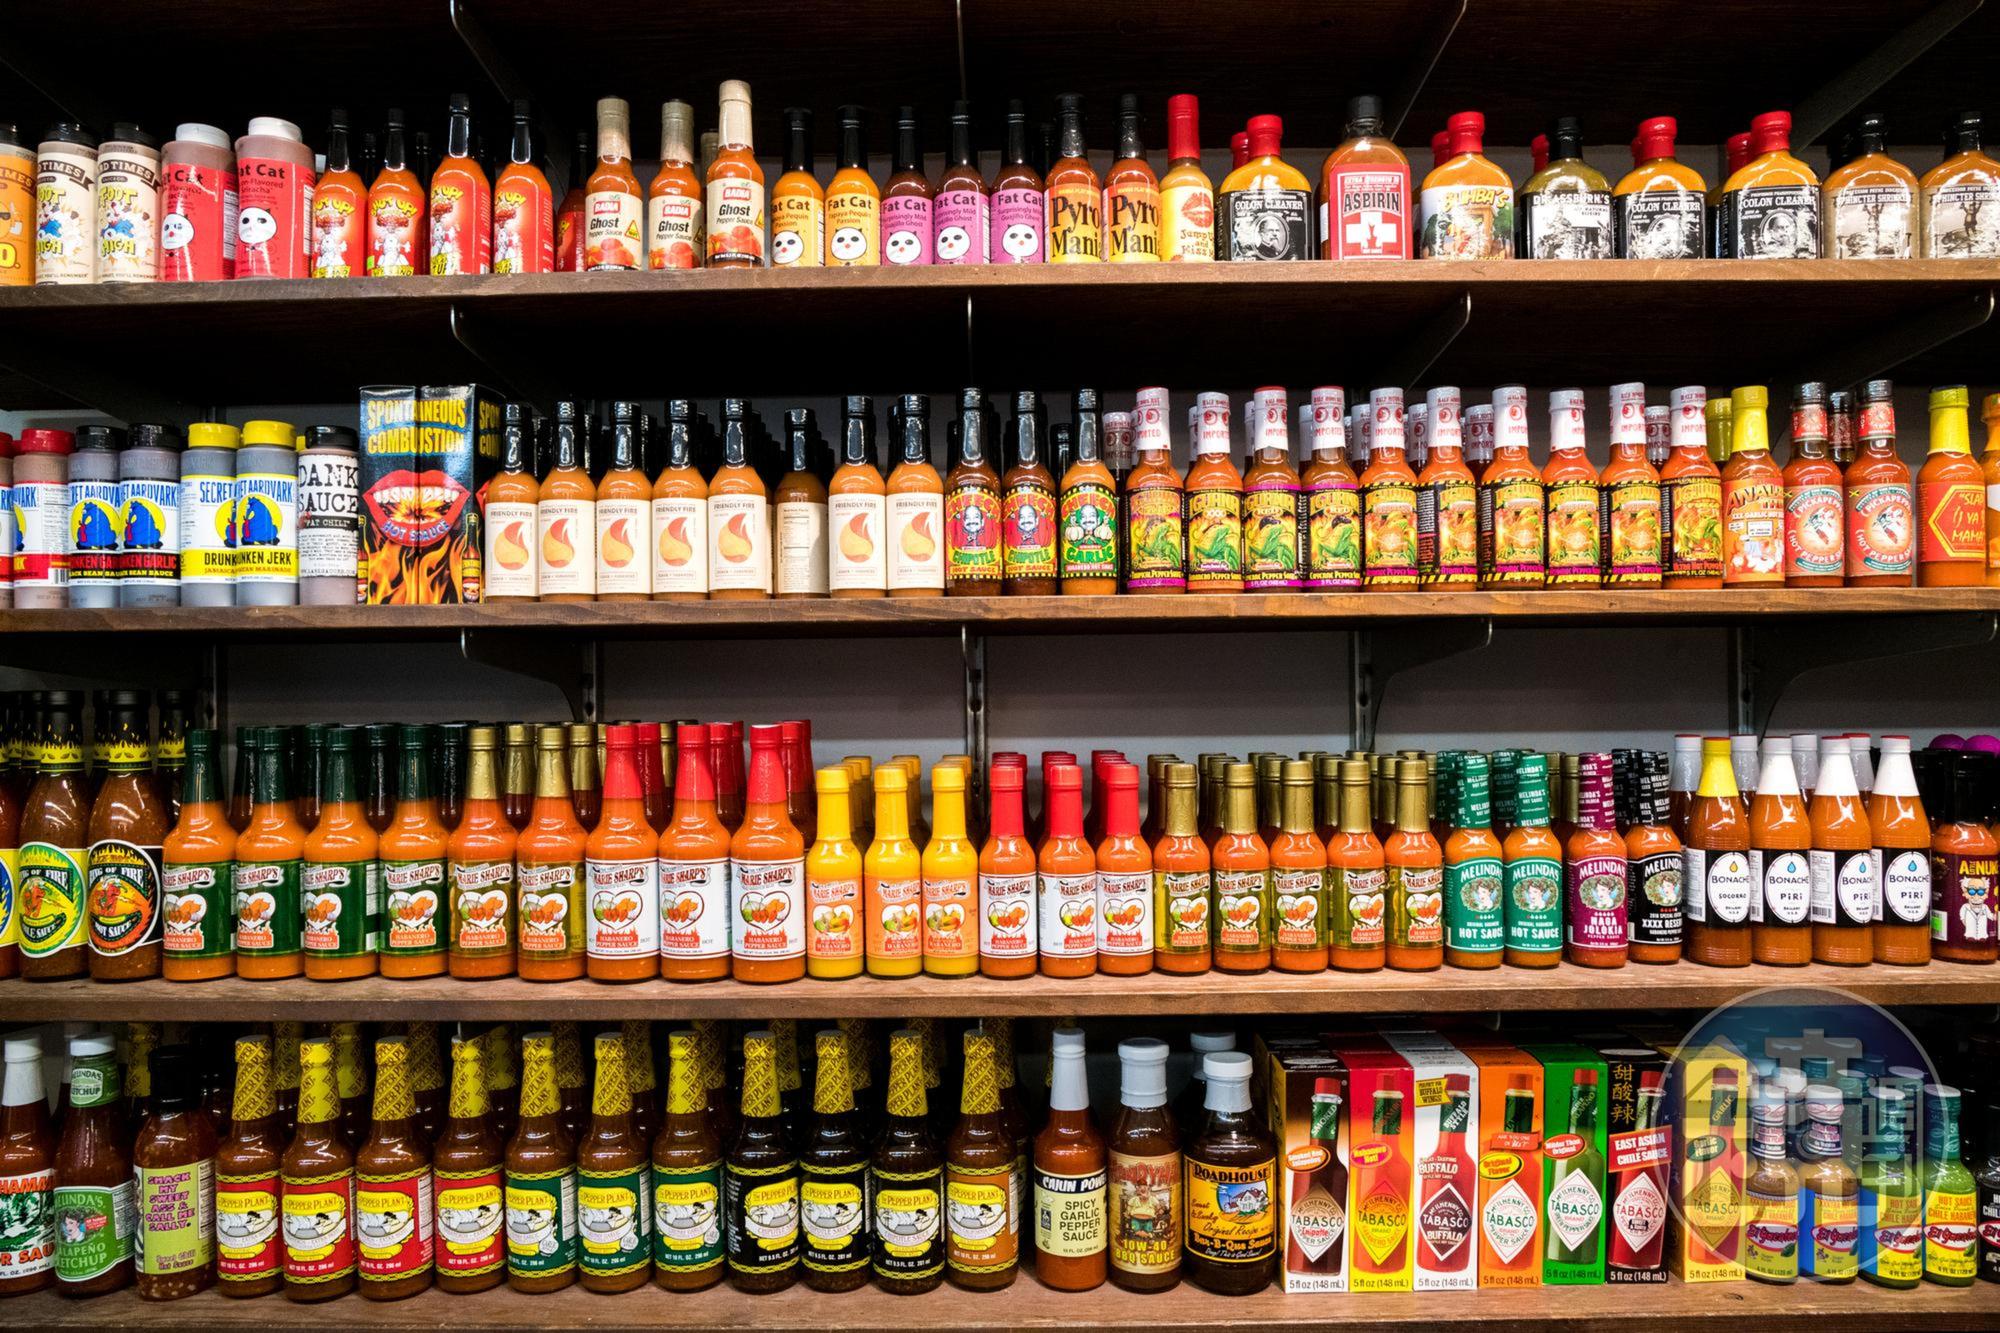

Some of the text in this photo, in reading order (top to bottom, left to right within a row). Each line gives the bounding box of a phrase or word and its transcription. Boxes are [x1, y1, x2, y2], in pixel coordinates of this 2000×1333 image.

[42, 161, 83, 179] TIMES
[111, 160, 152, 181] TIMES
[239, 163, 286, 180] at Cat
[827, 196, 872, 211] Fat Cat
[882, 198, 927, 215] Fat Cat
[997, 192, 1043, 208] Fat Cat
[1234, 199, 1304, 211] COLON CLEANER
[1343, 192, 1400, 214] ASBIRIN
[1631, 201, 1661, 213] COLON
[1743, 197, 1773, 209] COLON
[718, 204, 751, 217] Ghost
[1051, 195, 1100, 235] Pyro
[1111, 194, 1160, 232] Pyro
[590, 217, 620, 231] Ghost
[658, 220, 690, 233] Ghost
[1180, 228, 1208, 241] Jump
[1051, 228, 1101, 258] Mani
[1111, 228, 1160, 258] Mani
[366, 399, 467, 430] SPONTANEOUS
[367, 427, 465, 455] COMBUSTION
[298, 463, 358, 489] DANK
[130, 482, 177, 508] AARDVARK
[199, 481, 232, 503] SECRET
[248, 480, 293, 503] AARDVARK
[298, 491, 358, 514] SAUCE
[382, 519, 450, 542] HOT SAUCE
[144, 555, 177, 570] GARLIC
[1066, 546, 1114, 563] GARLIC
[247, 867, 279, 883] SHARP'S
[315, 867, 345, 883] SHARP'S
[386, 864, 441, 885] MARIE SHARP'S
[457, 864, 510, 886] MARIE SHARP'S
[614, 866, 645, 883] SHARP'S
[675, 866, 706, 883] SHARP'S
[741, 865, 792, 885] MARIE SHARP'S
[1959, 860, 1998, 875] A NUK
[45, 867, 69, 890] FIRE
[121, 867, 145, 888] FIRE
[181, 867, 211, 885] SHARP'S
[1590, 915, 1617, 926] NAGA
[1459, 927, 1503, 940] HOT SAUCE
[1511, 926, 1560, 939] HOT SAUCE
[1583, 926, 1623, 936] JOLOKIA
[1419, 1086, 1444, 1097] BUFFALO
[1610, 1064, 1636, 1125] 甜酸辣
[1711, 1094, 1734, 1122] GARLIC
[1310, 1103, 1338, 1137] SMOKED
[1614, 1132, 1666, 1151] EAST ASIAN
[1617, 1148, 1668, 1166] CHILE SAUCE
[1194, 1164, 1269, 1184] ROADHOUSE
[1418, 1162, 1459, 1175] BUFFALO
[147, 1172, 191, 1185] SMACK
[1042, 1174, 1107, 1192] CAJUN POWE
[159, 1183, 179, 1193] MY
[978, 1190, 1000, 1201] PLANT
[149, 1191, 190, 1204] SWEET
[525, 1195, 549, 1206] PLANT
[1064, 1198, 1097, 1211] SPICY
[151, 1202, 188, 1214] ASS &
[1059, 1208, 1101, 1222] GARLIC
[1551, 1199, 1600, 1216] TABASCO
[1616, 1203, 1664, 1219] TABASCO
[145, 1209, 196, 1223] CALL ME
[1058, 1217, 1102, 1231] PEPPER
[1423, 1213, 1469, 1228] TABASCO
[1486, 1211, 1534, 1228] TABASCO
[149, 1219, 192, 1232] SALLY.
[1062, 1228, 1099, 1242] SAUCE
[1426, 1229, 1464, 1242] BUFFALO
[1123, 1239, 1167, 1251] 10W-40
[1115, 1249, 1176, 1265] BBQ SAUCE
[1353, 1280, 1359, 1288] 5
[1359, 1279, 1365, 1288] fl
[1376, 1278, 1392, 1289] (148
[1392, 1278, 1409, 1289] mL)
[1610, 1273, 1616, 1281] 5
[1616, 1272, 1622, 1281] fl
[1634, 1271, 1650, 1282] (148
[1651, 1271, 1667, 1282] mL)
